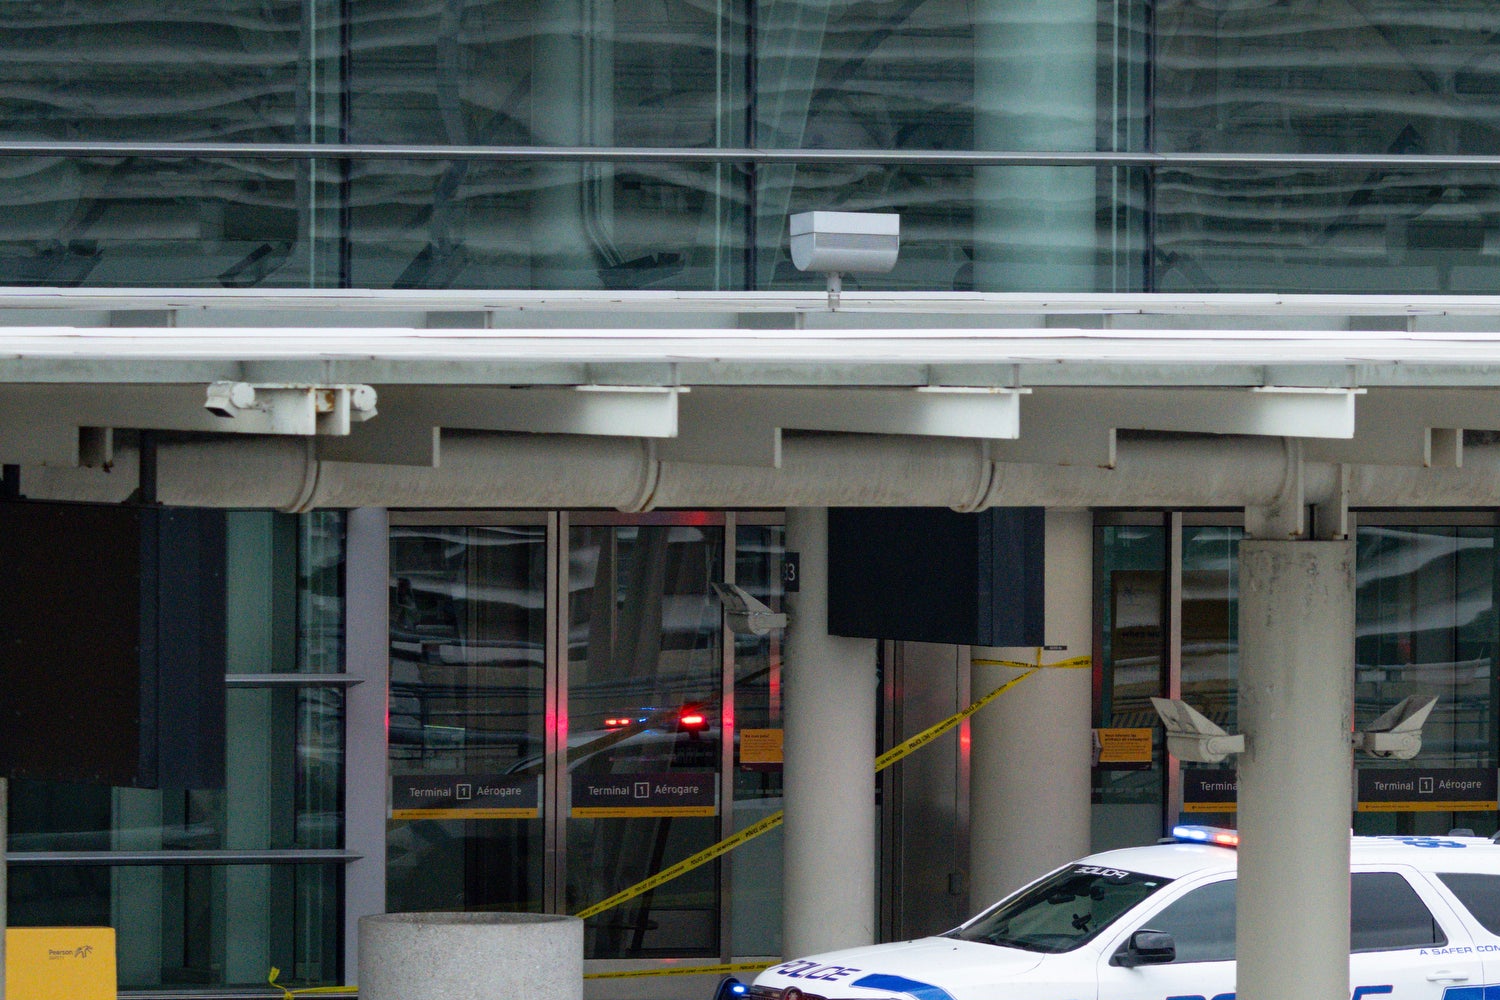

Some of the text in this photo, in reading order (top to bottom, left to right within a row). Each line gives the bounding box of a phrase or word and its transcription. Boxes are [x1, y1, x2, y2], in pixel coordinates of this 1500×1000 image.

[409, 787, 452, 798] Terminal
[477, 785, 522, 797] Aérogare
[588, 785, 630, 796] Terminal
[654, 783, 700, 796] Aérogare
[1200, 781, 1238, 791] Termina
[1374, 781, 1414, 792] Terminal
[1438, 779, 1482, 791] Aérogare
[1431, 946, 1473, 956] SAFER
